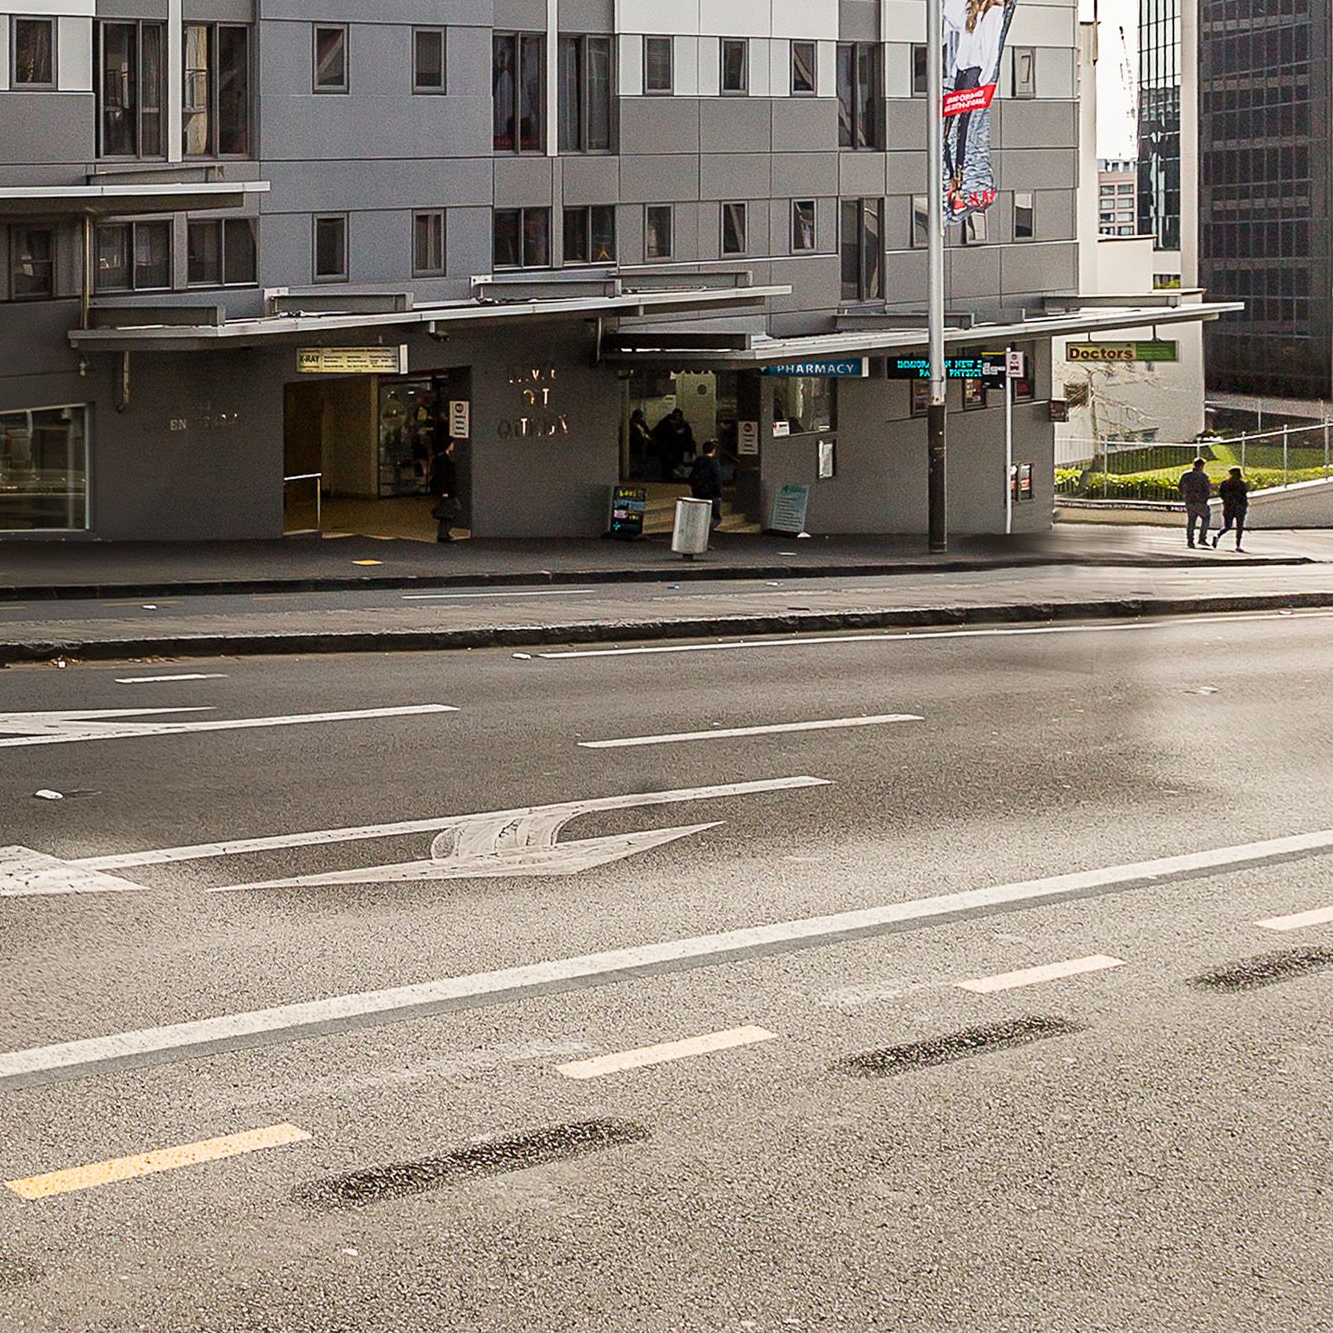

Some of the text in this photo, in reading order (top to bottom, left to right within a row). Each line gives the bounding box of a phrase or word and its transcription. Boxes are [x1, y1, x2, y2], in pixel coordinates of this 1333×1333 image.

[1069, 348, 1133, 359] Doctors
[299, 354, 320, 363] X-RAY
[955, 360, 973, 368] NEW
[777, 364, 855, 374] PHARMACY
